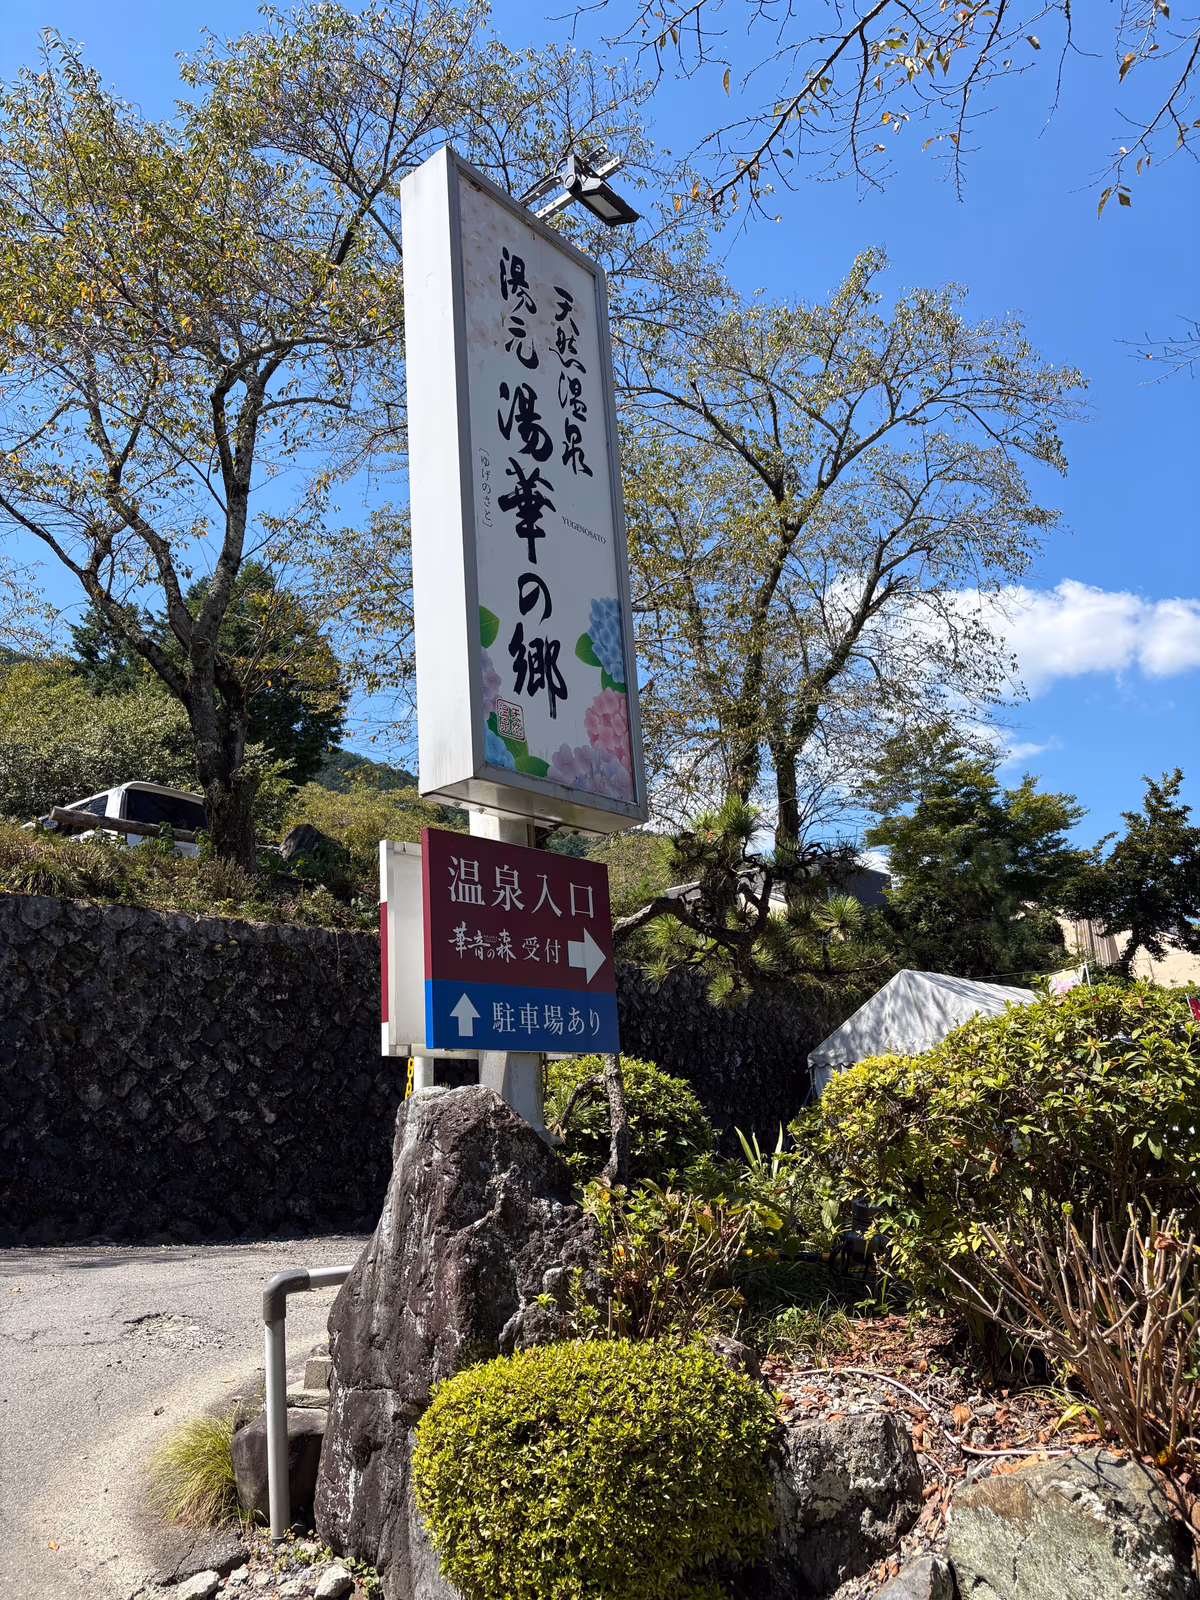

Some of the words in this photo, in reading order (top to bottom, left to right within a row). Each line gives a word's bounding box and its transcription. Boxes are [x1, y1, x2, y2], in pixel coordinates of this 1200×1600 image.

[548, 286, 593, 477] 天然温泉
[561, 515, 607, 545] YUGENOSATO
[448, 855, 595, 919] 温泉入口
[492, 1001, 601, 1037] 駐車場あり
